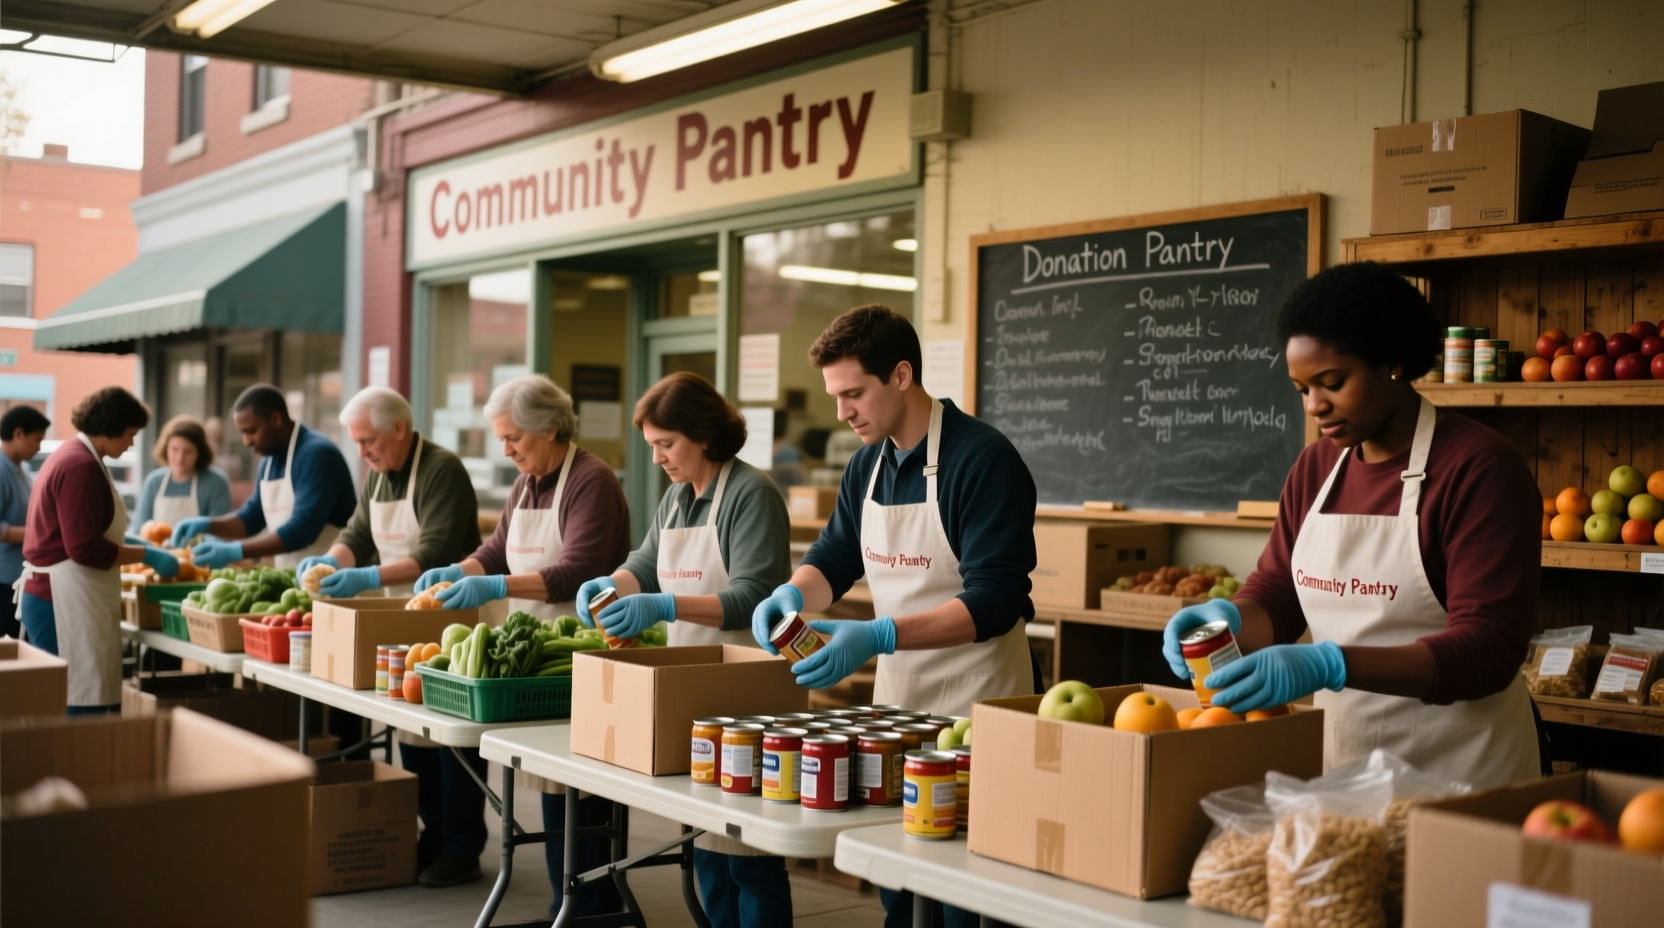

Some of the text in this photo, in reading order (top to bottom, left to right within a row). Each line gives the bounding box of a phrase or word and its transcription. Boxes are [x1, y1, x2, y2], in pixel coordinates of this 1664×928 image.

[430, 89, 876, 240] Community Pantry
[1022, 231, 1235, 284] Donation Pantry
